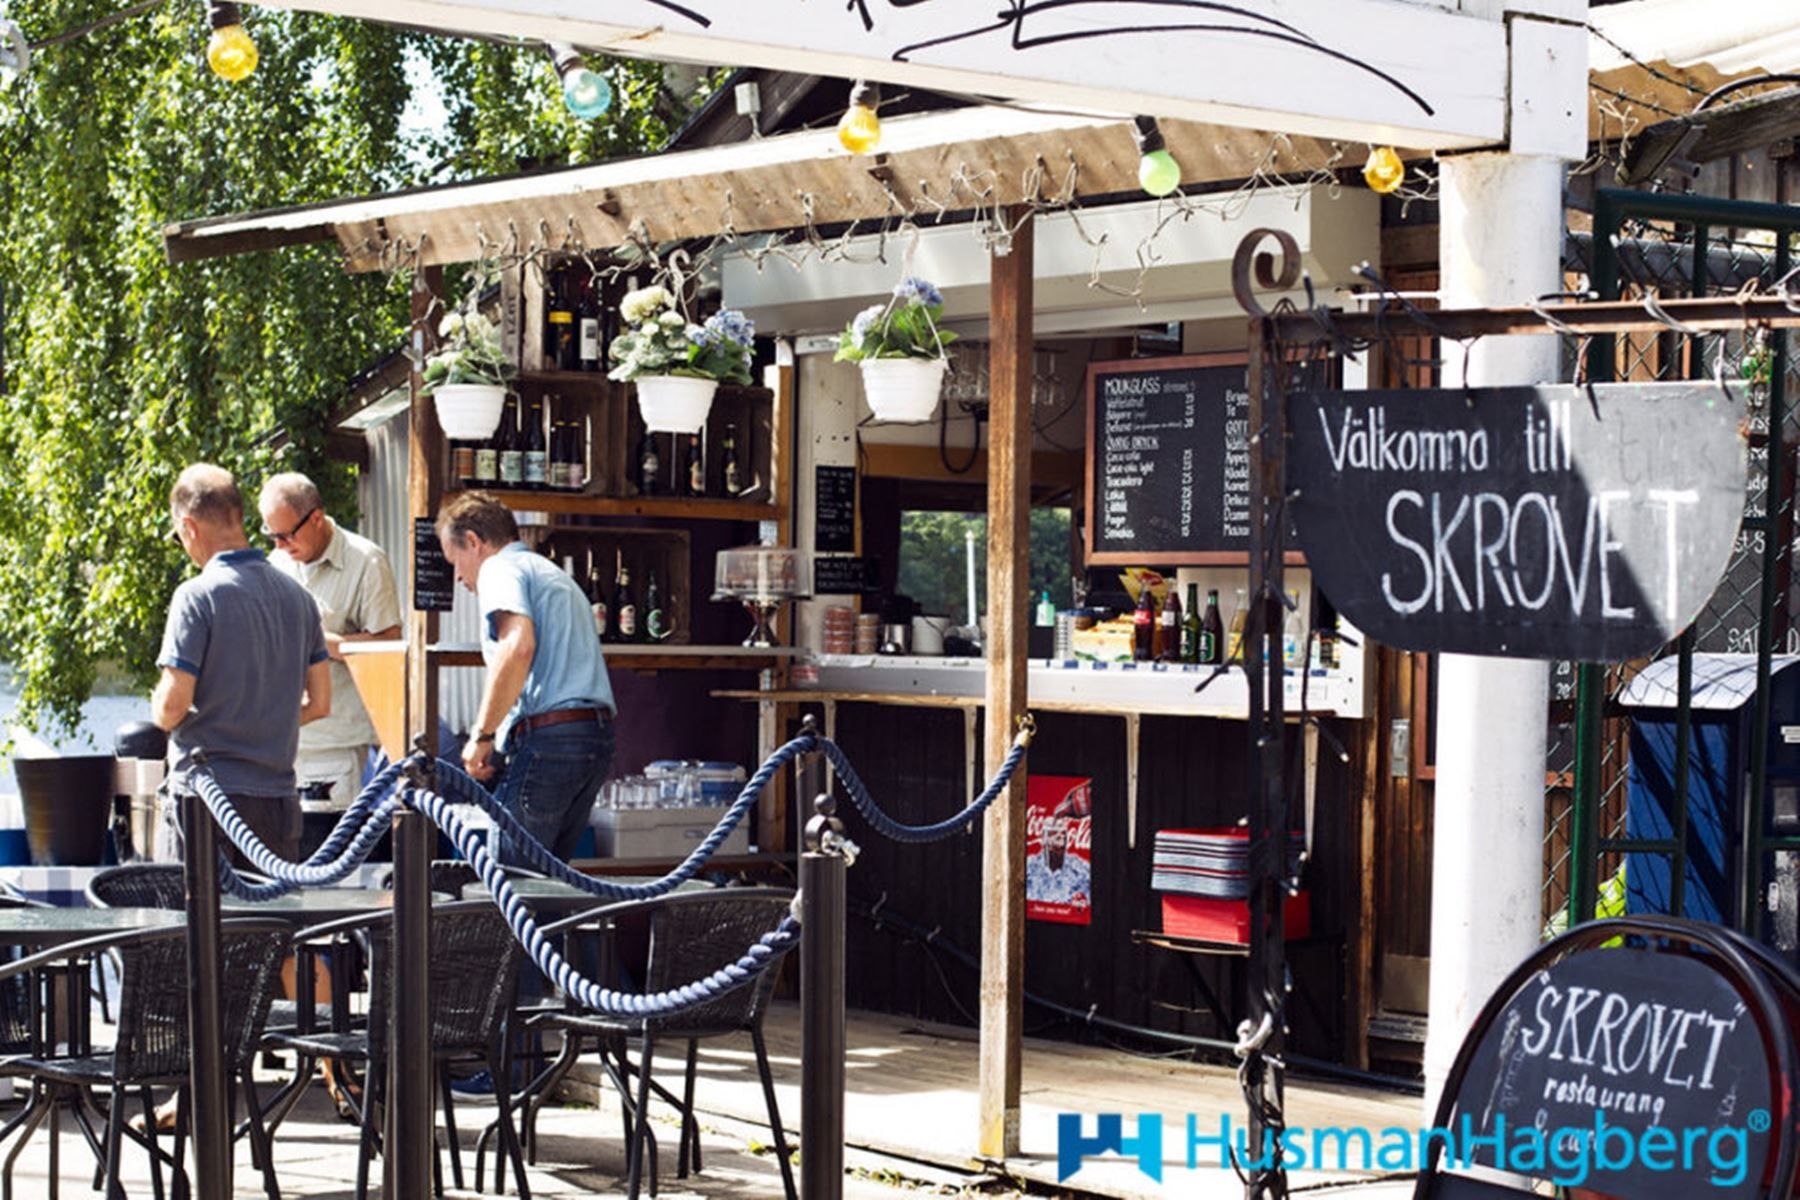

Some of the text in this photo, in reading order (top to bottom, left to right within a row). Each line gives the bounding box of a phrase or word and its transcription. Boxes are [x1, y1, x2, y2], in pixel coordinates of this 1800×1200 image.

[1318, 400, 1571, 473] Välkomna till
[1381, 489, 1698, 620] SKROVET
[1543, 1073, 1665, 1128] restaurang
